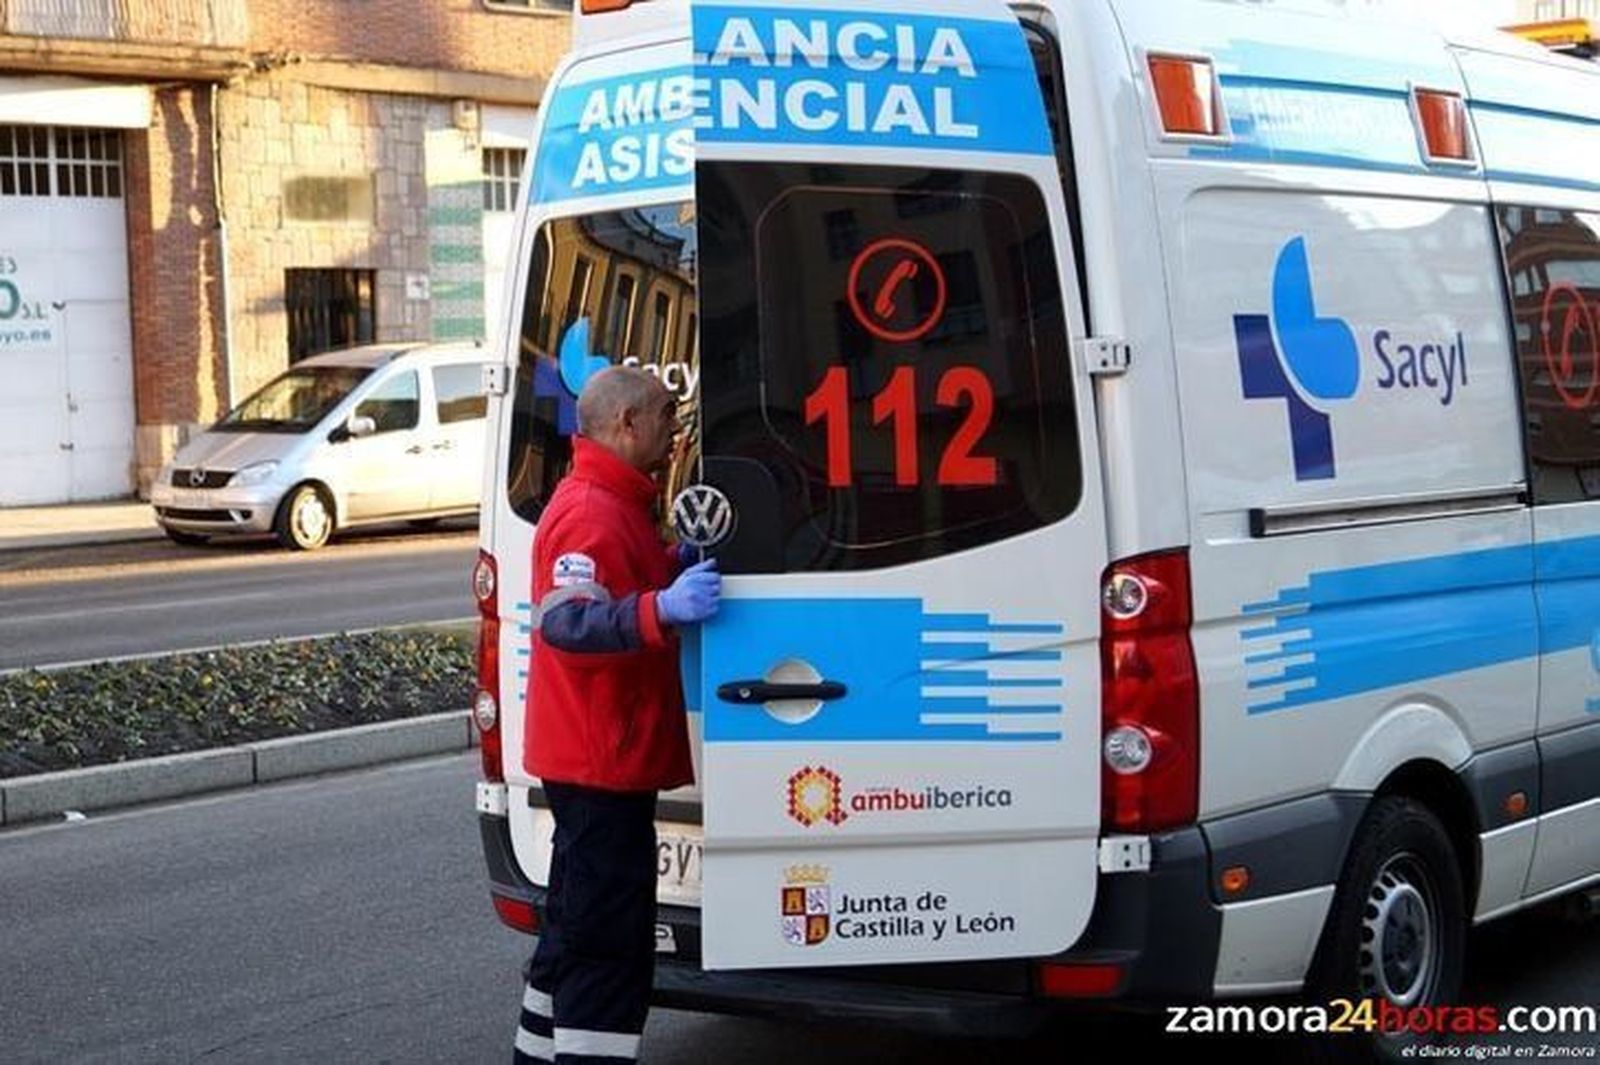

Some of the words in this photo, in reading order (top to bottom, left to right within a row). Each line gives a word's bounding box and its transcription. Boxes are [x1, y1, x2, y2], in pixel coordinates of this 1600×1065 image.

[693, 16, 978, 78] ANCIA
[578, 74, 693, 133] AMB
[571, 128, 695, 188] ASIS
[1373, 330, 1467, 405] Sacyl
[805, 366, 996, 487] 112
[851, 786, 1012, 812] ambuiberica
[835, 916, 924, 939] Castilla
[932, 919, 947, 941] y
[956, 911, 1014, 934] León
[836, 894, 907, 915] Junta
[916, 891, 947, 911] de
